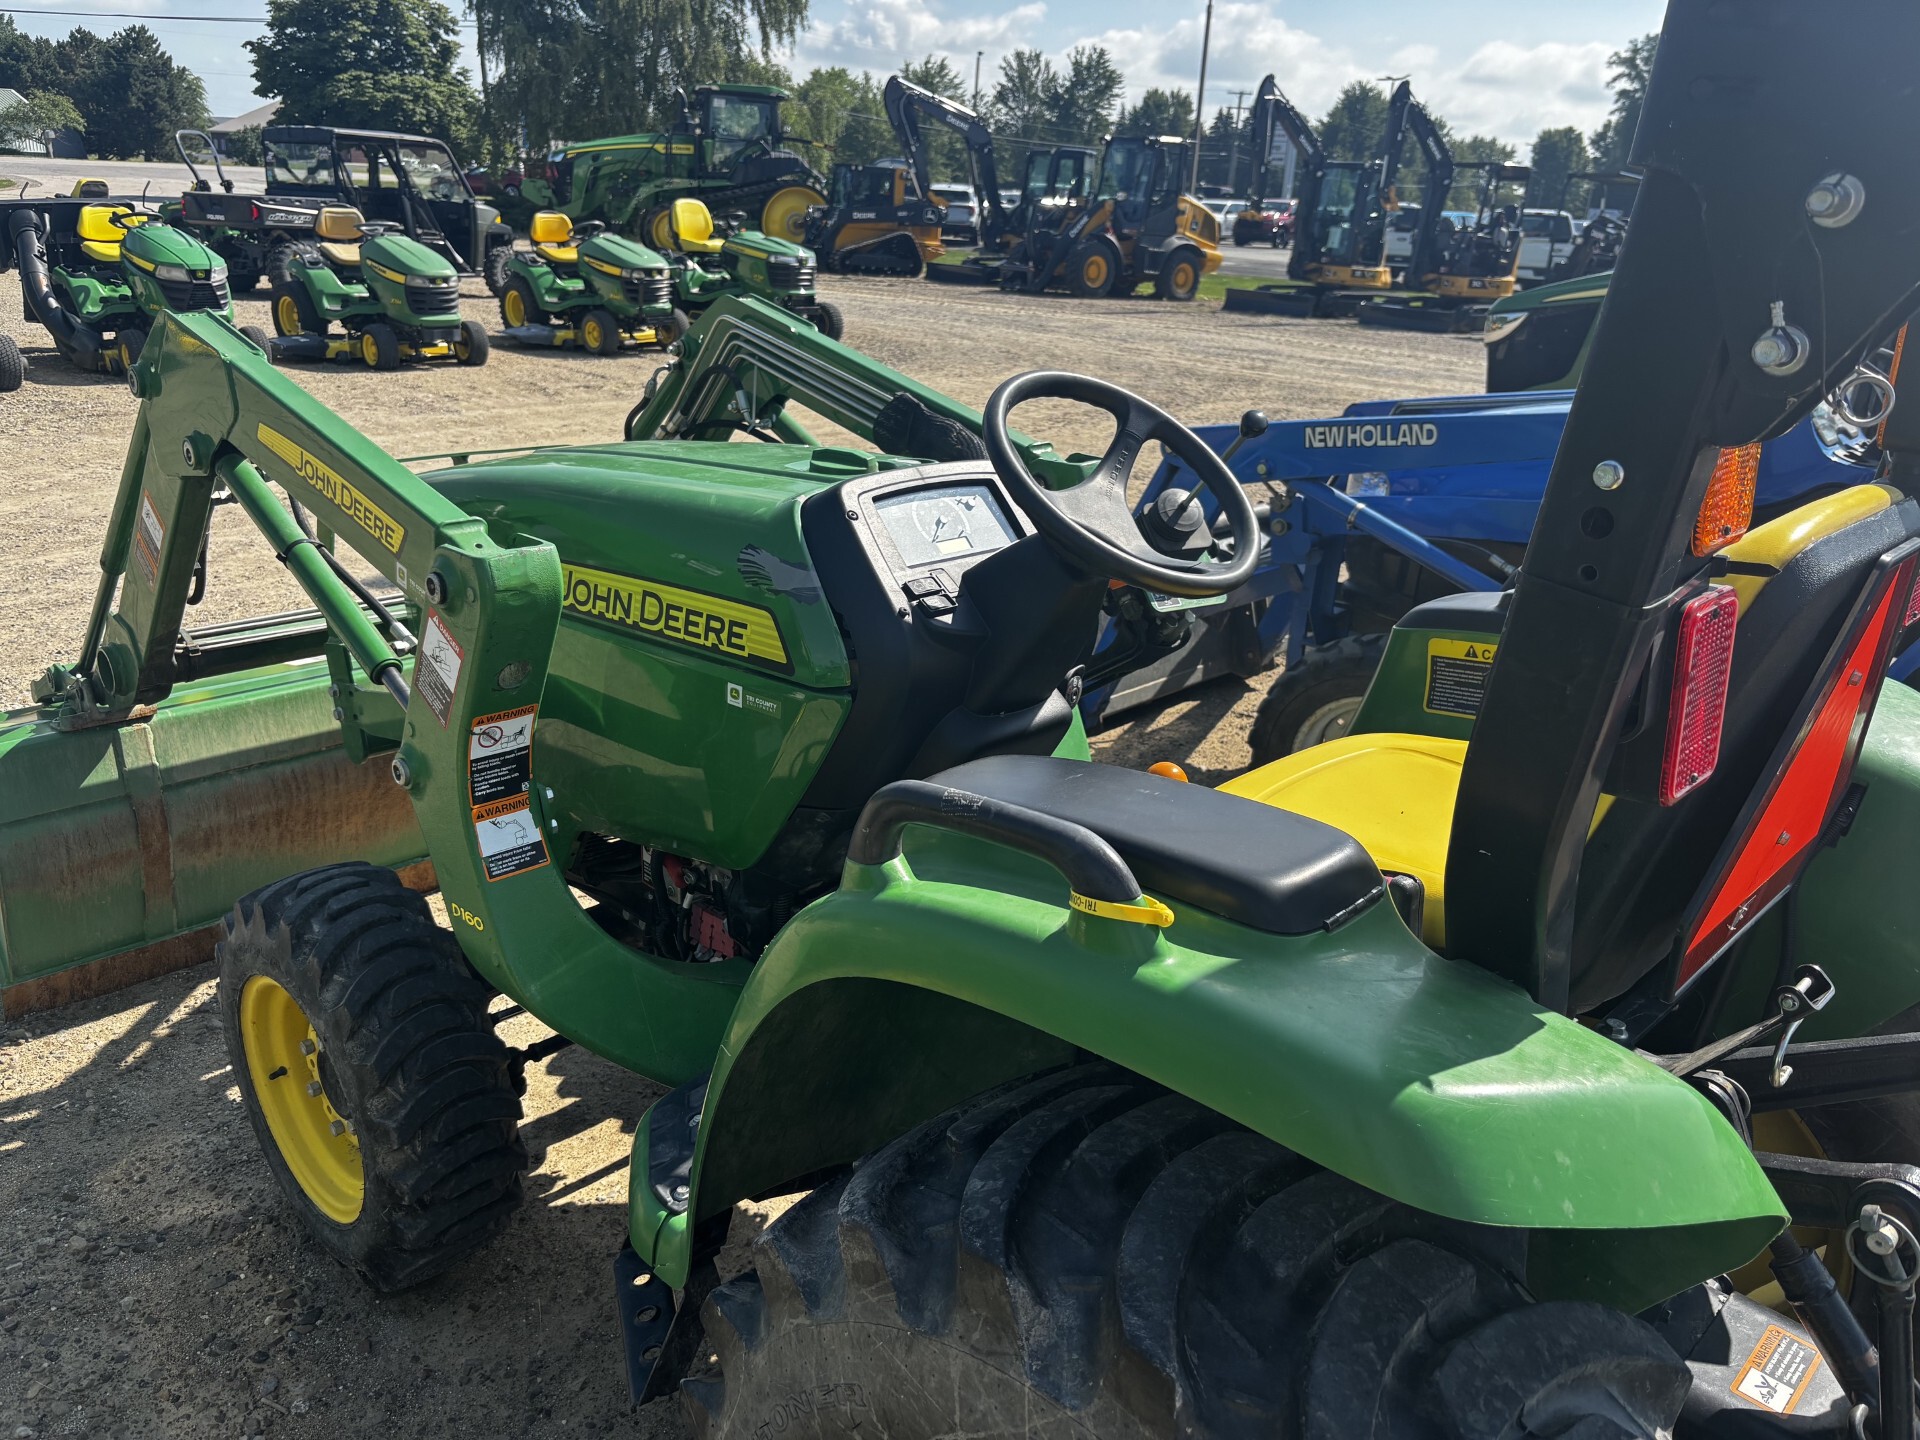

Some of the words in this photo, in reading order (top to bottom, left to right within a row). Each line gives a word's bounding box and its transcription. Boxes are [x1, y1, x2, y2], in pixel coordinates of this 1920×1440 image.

[946, 114, 970, 130] DEERE
[1304, 426, 1345, 448] NEW
[1347, 423, 1438, 447] HOLLAND
[295, 450, 337, 502] JOHN
[341, 482, 396, 550] DEERE
[564, 570, 633, 620] JOHN
[640, 590, 748, 651] DEERE
[438, 624, 460, 654] DANGER
[486, 706, 534, 722] WARNING
[746, 694, 754, 702] TRI
[756, 698, 777, 709] COUNTY
[485, 798, 530, 816] WARNING
[452, 902, 484, 930] D160
[1754, 1329, 1782, 1364] WARNING
